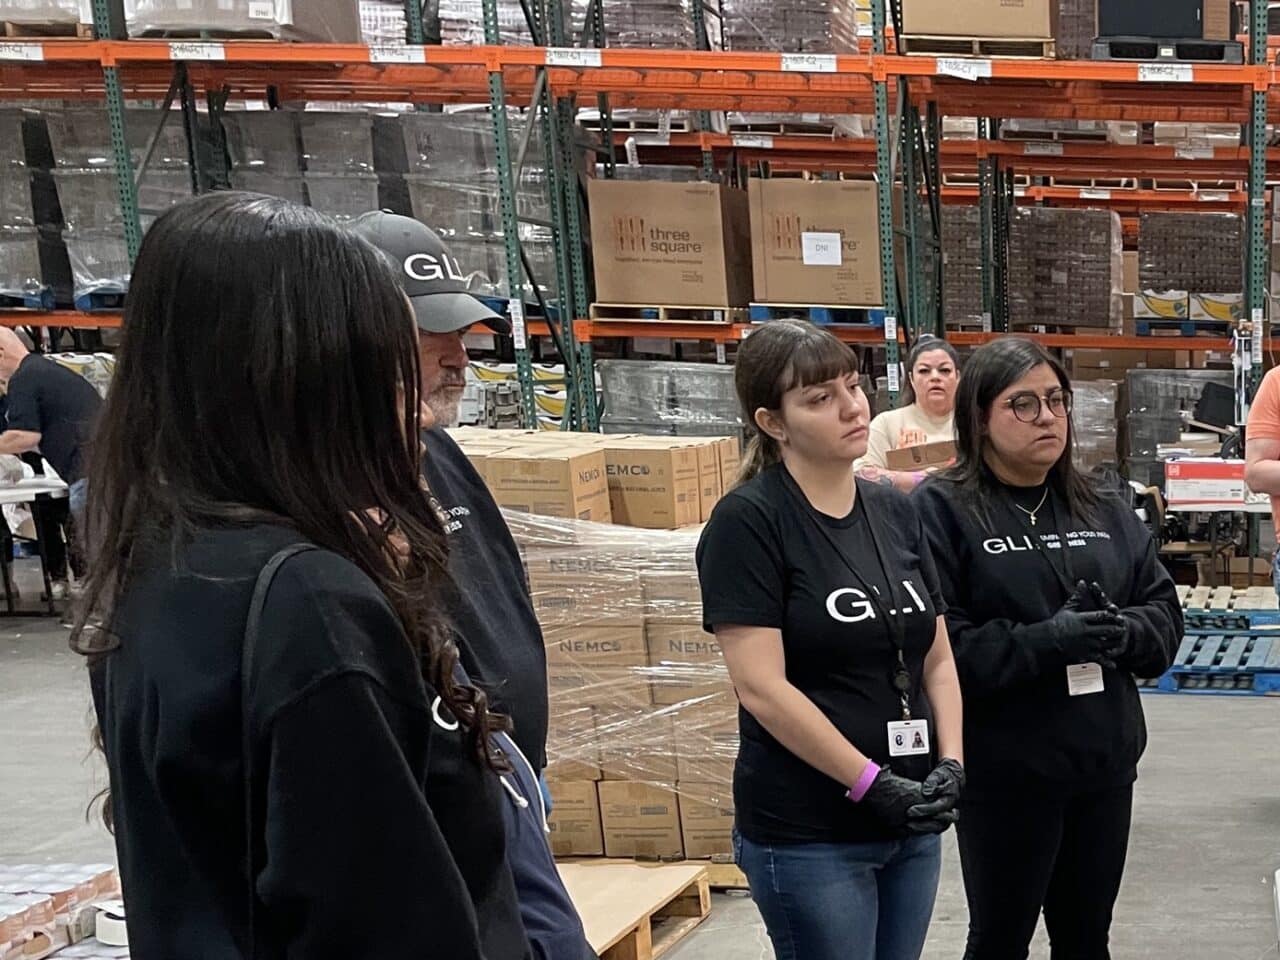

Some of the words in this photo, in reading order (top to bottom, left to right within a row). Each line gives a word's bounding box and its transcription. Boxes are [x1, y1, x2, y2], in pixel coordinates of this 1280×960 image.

[650, 228, 690, 241] three
[650, 241, 702, 254] square
[605, 464, 651, 476] EMCO
[983, 535, 1033, 554] GLI
